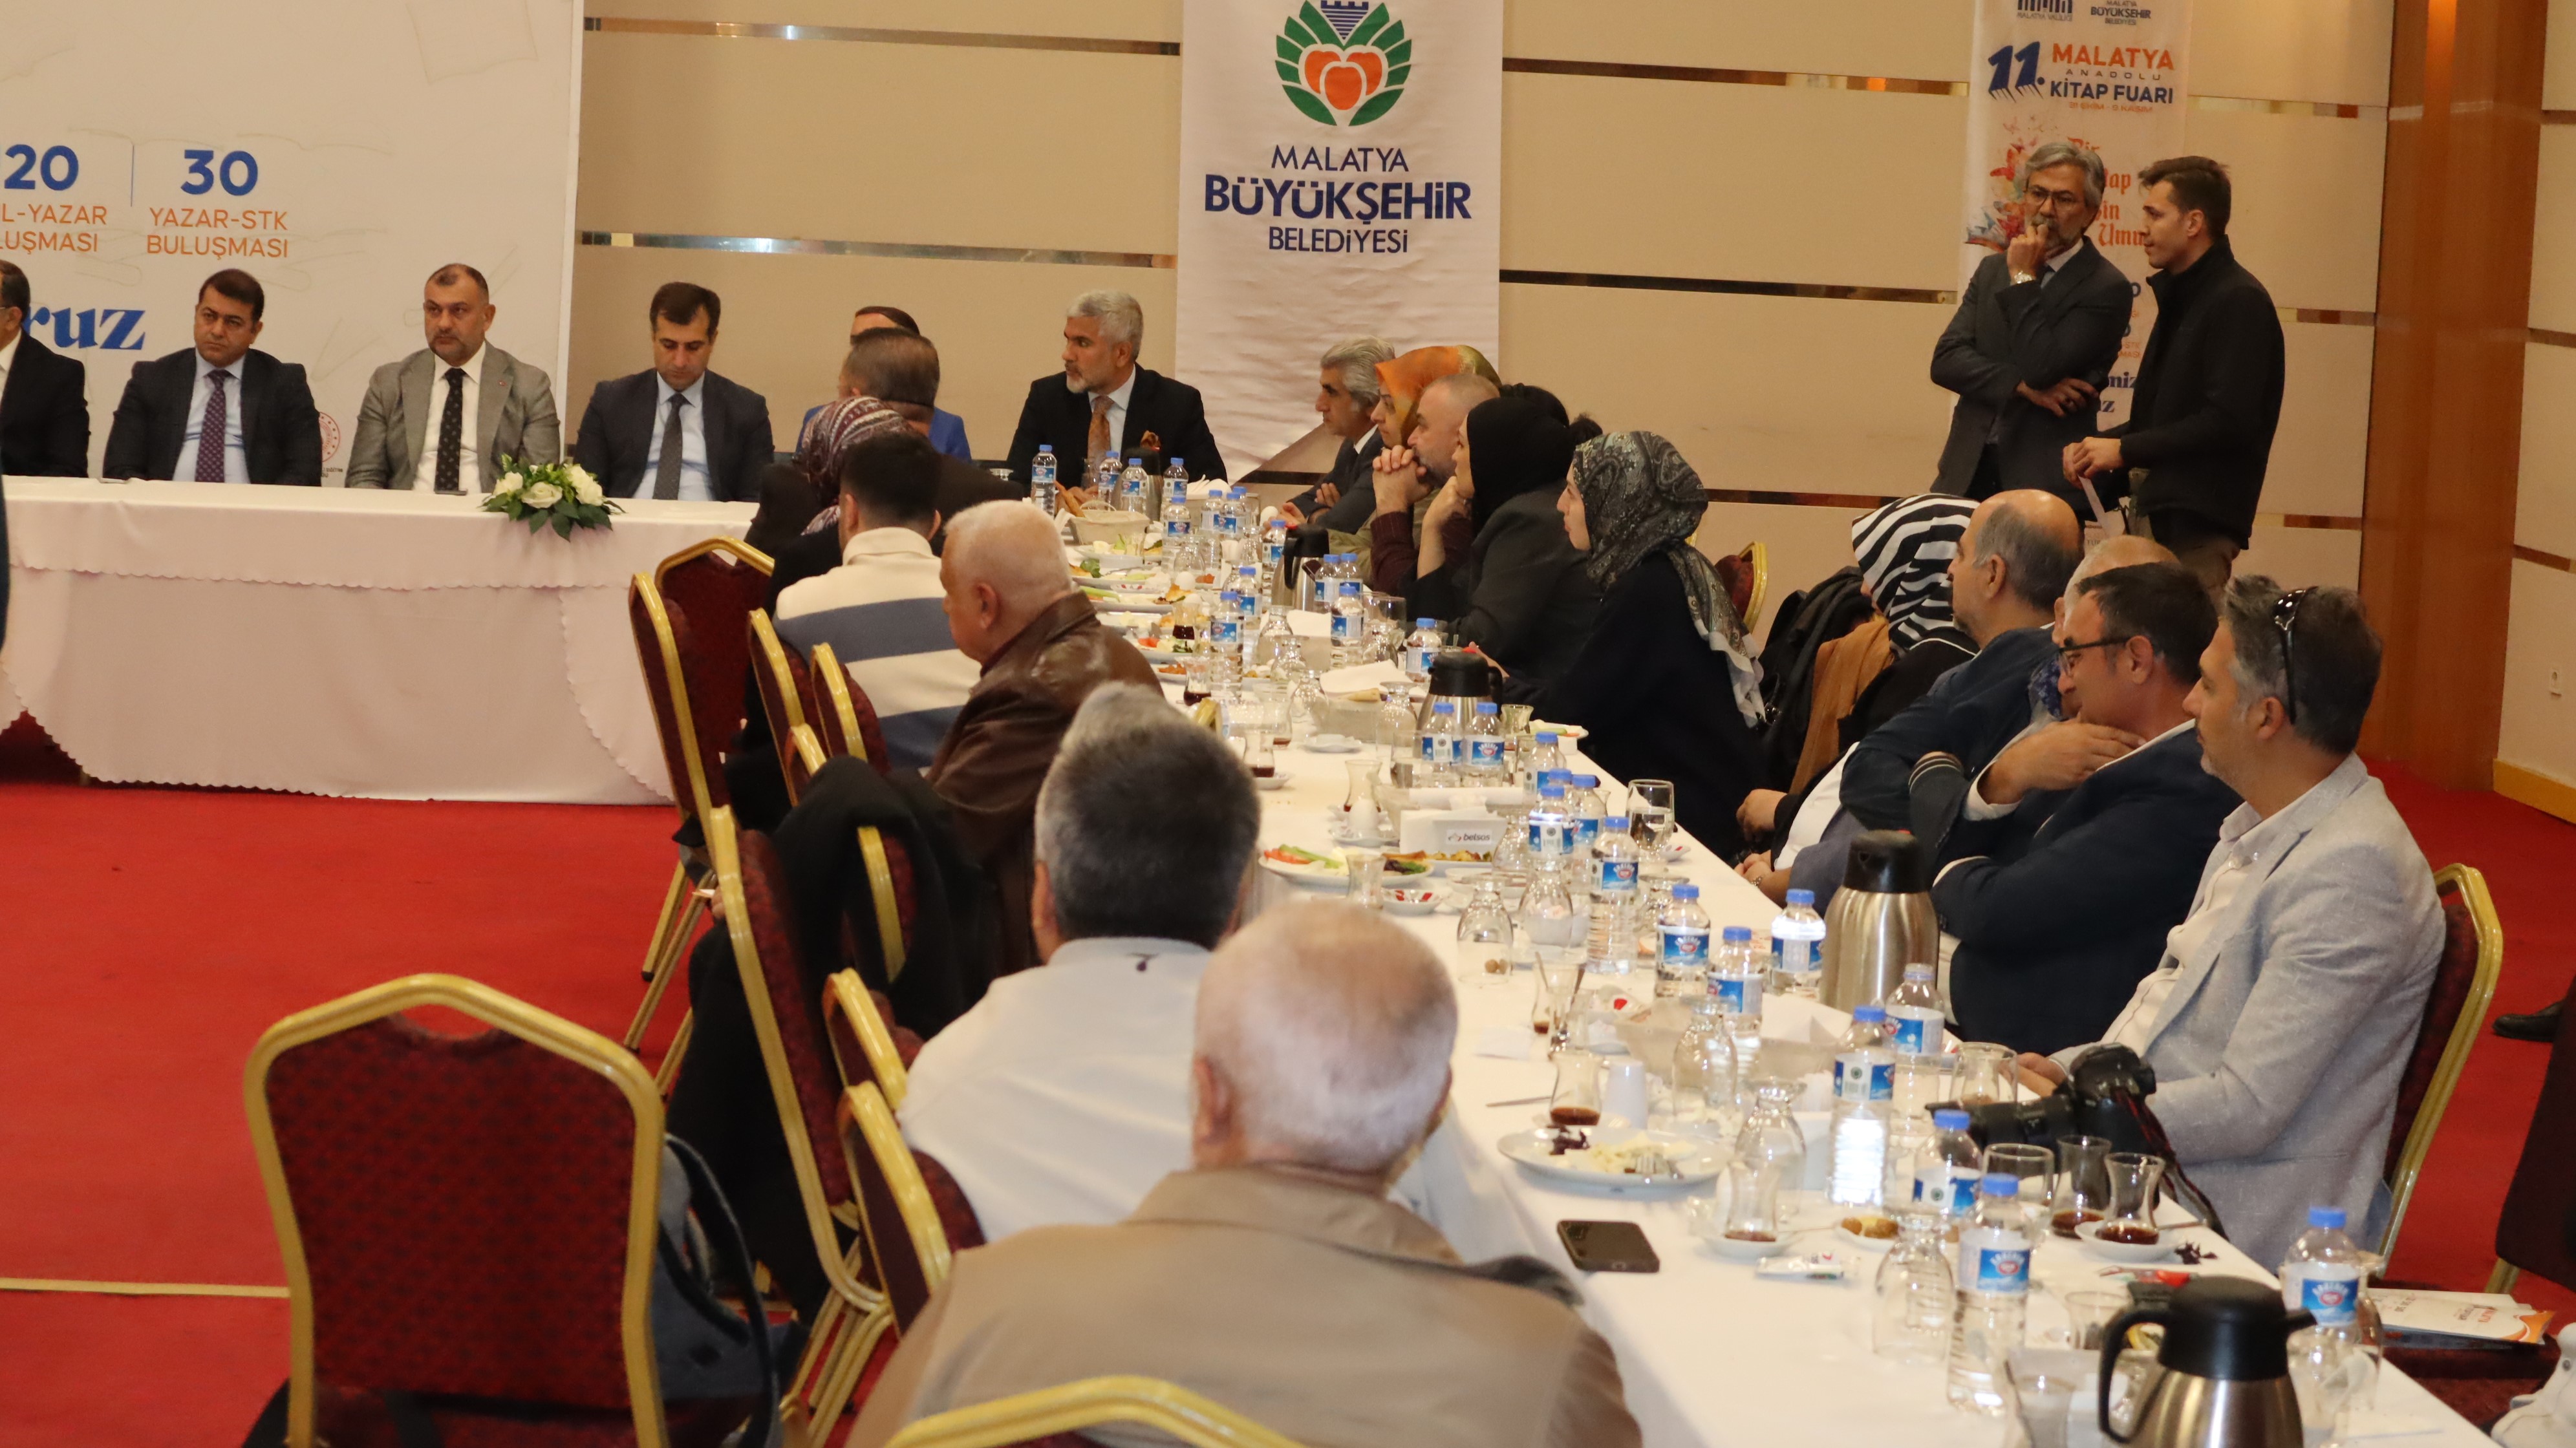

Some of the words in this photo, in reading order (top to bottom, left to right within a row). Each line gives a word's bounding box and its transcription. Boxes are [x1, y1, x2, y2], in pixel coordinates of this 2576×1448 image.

[2052, 43, 2174, 70] MALATYA
[1988, 41, 2045, 101] 11.
[2066, 69, 2161, 81] ANADOLU
[2050, 78, 2108, 100] KİTAP
[2114, 84, 2173, 103] FUARI
[4, 144, 79, 191] 20
[1271, 144, 1409, 172] MALATYA
[180, 150, 259, 196] 30
[1205, 174, 1472, 224] BÜYÜKŞEHİR
[149, 208, 288, 231] YAZAR-STK
[146, 235, 288, 261] BULUŞMASI
[1269, 227, 1408, 253] BELEDİYESİ
